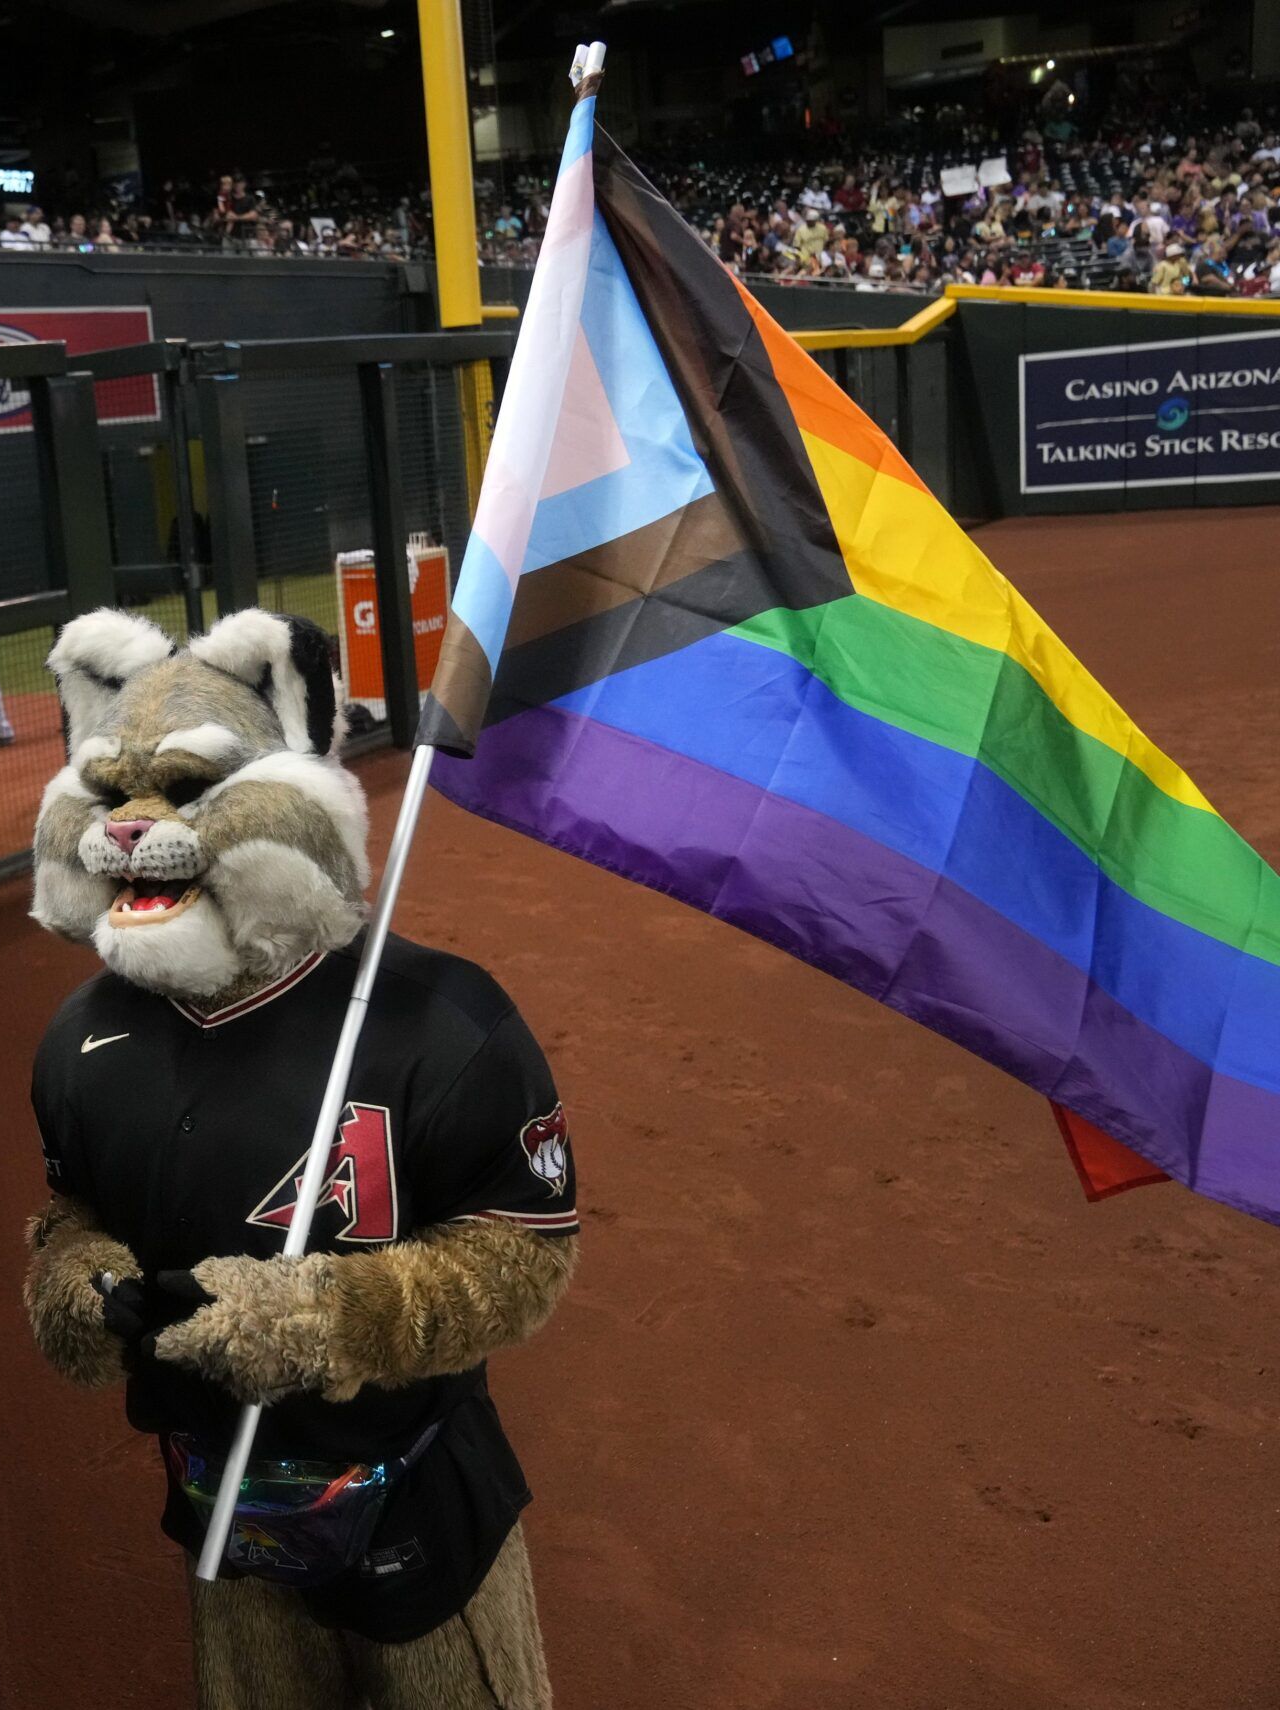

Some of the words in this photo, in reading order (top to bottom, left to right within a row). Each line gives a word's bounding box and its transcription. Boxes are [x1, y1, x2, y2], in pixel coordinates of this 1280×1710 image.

[1064, 378, 1159, 402] CASINO
[1035, 442, 1138, 464] TALKING
[1144, 434, 1215, 458] STICK
